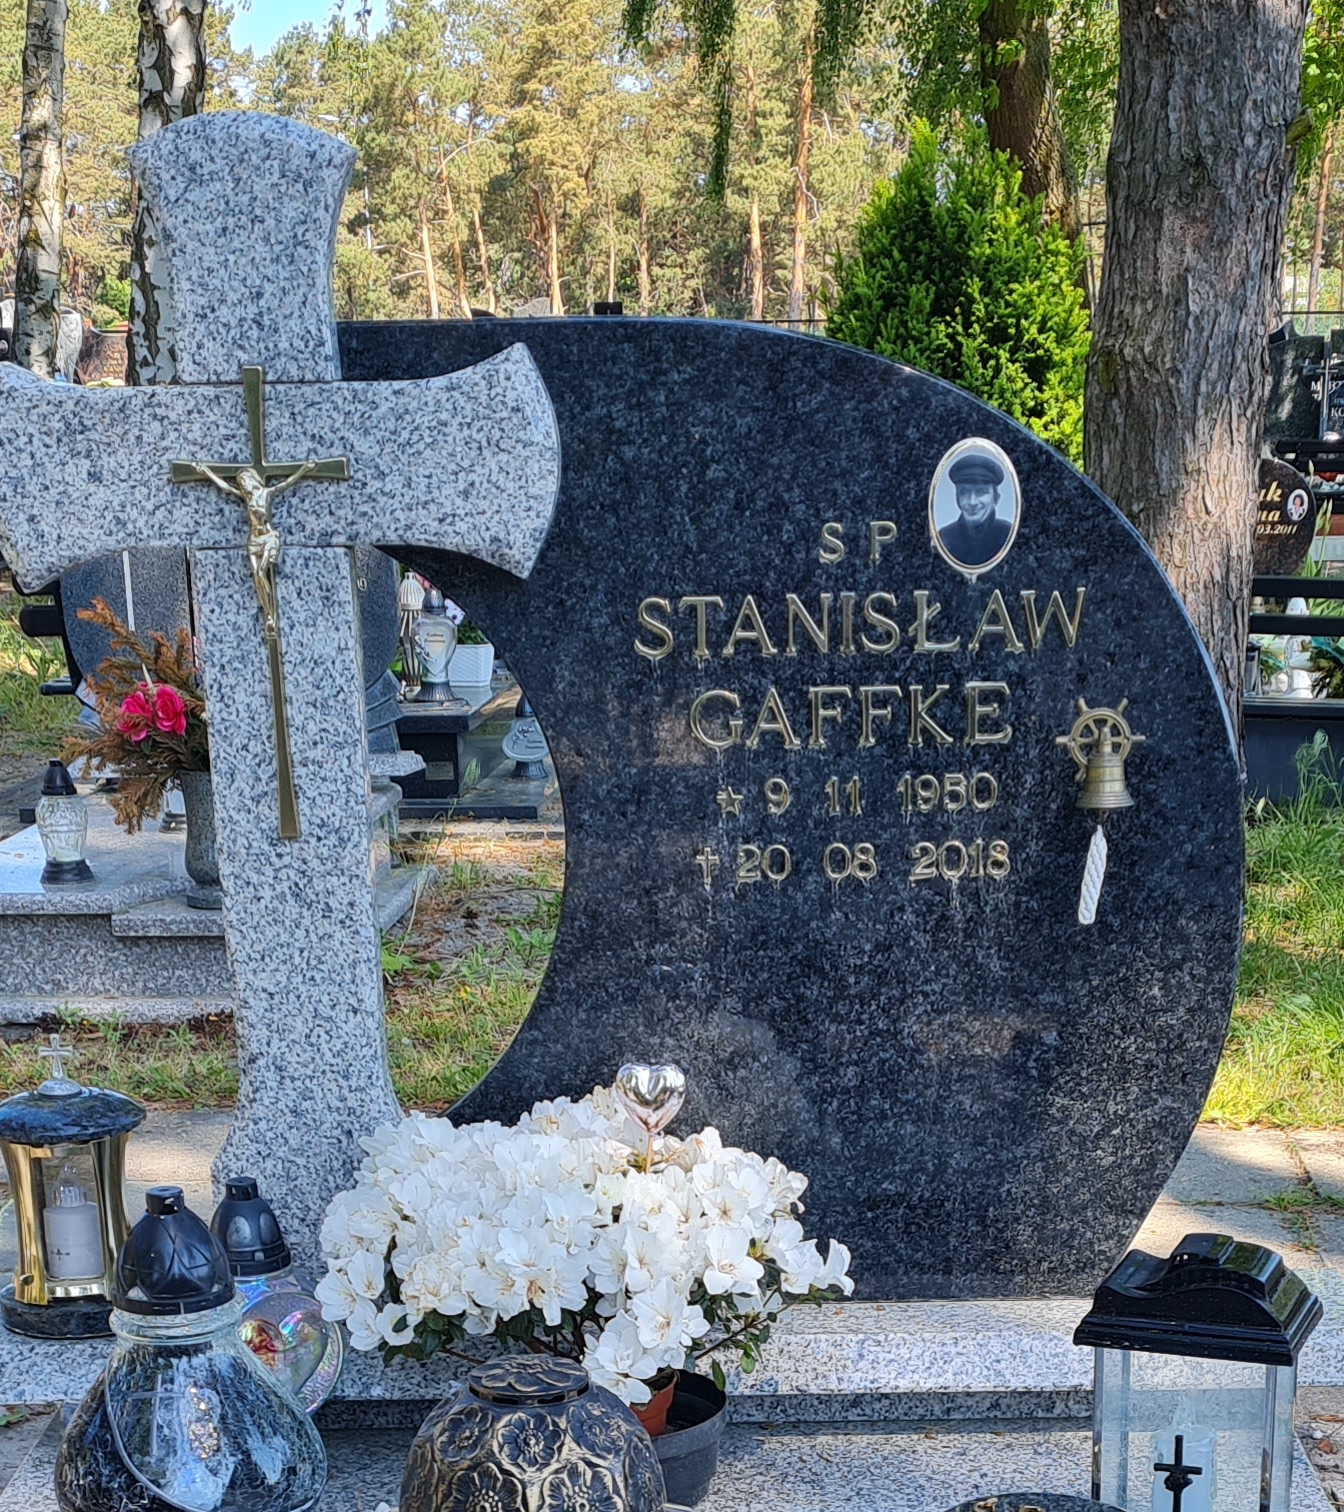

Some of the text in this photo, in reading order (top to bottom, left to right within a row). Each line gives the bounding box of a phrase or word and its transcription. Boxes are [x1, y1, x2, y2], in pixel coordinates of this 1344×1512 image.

[868, 520, 898, 563] P
[633, 586, 1087, 660] STANISŁAW
[689, 680, 1014, 751] GAFFKE
[763, 771, 999, 817] 9 11 1950
[736, 837, 1012, 884] 20 08 2018
